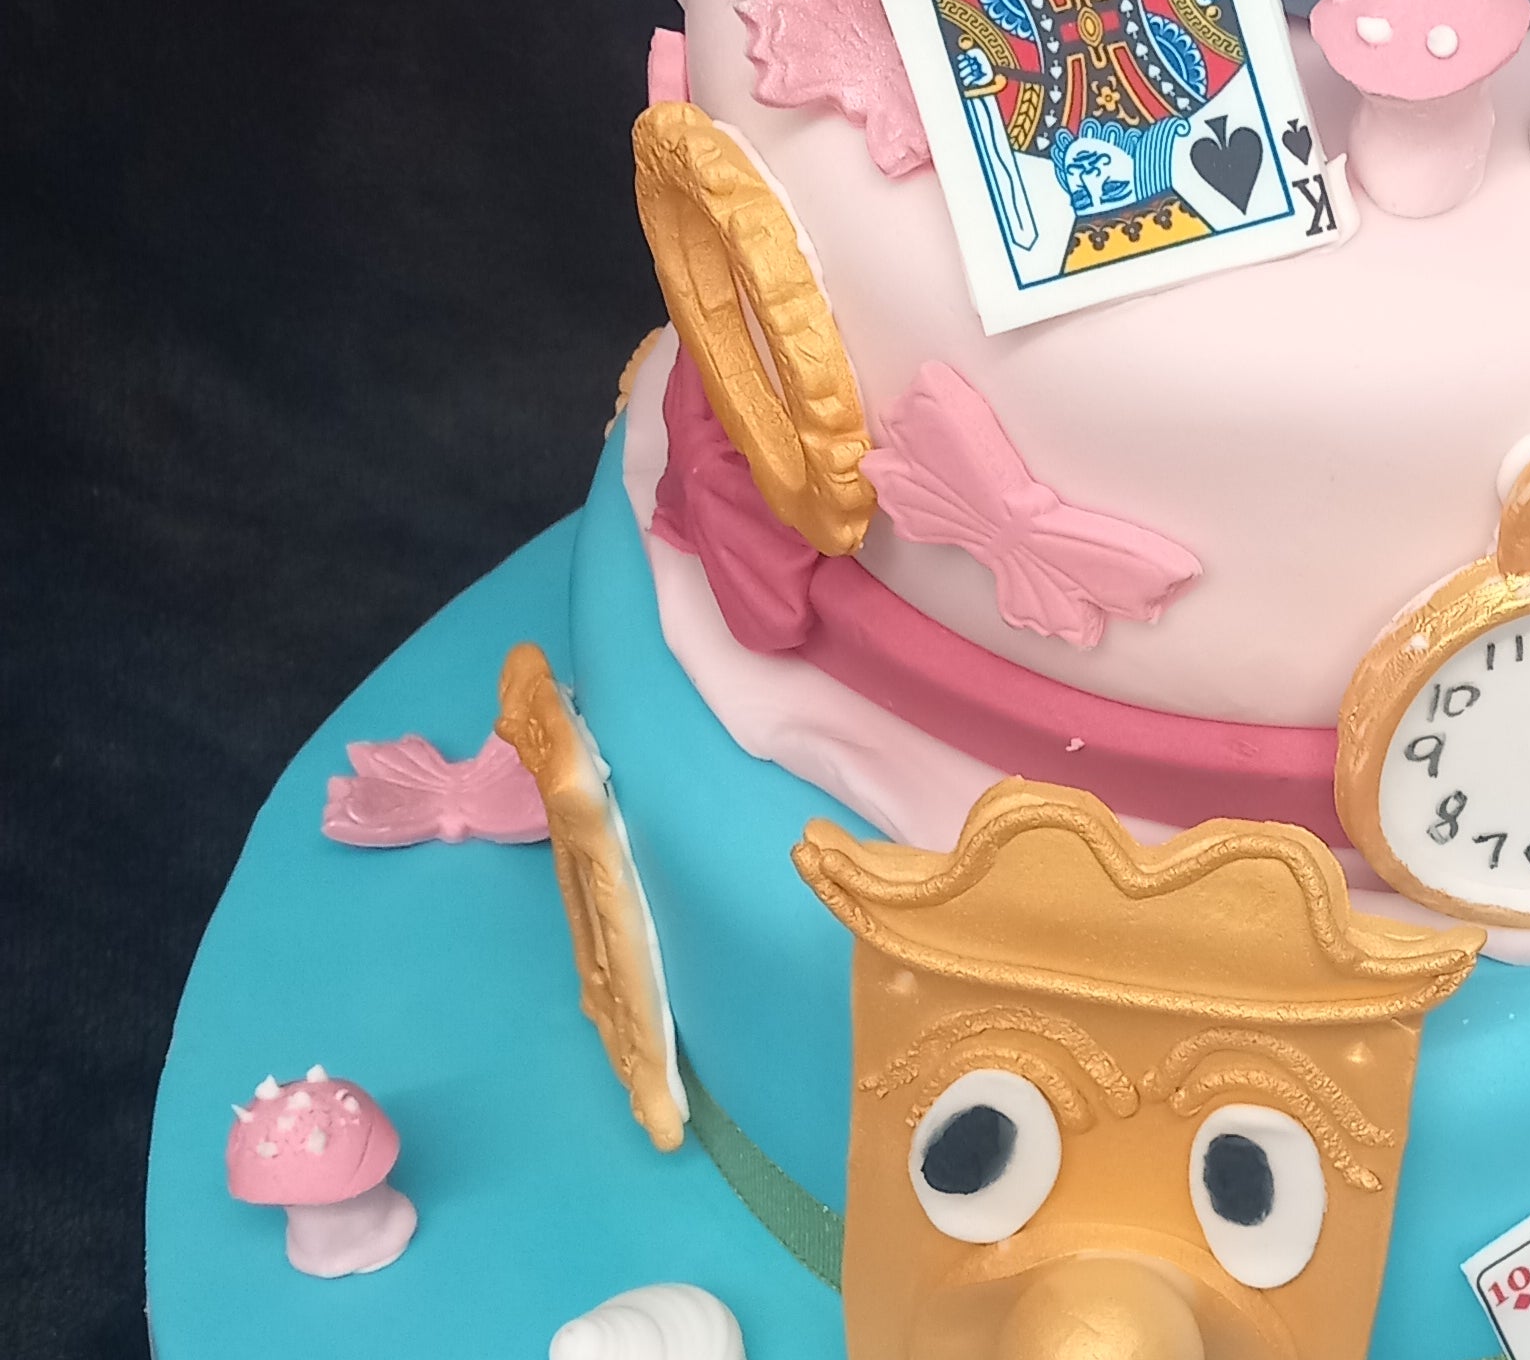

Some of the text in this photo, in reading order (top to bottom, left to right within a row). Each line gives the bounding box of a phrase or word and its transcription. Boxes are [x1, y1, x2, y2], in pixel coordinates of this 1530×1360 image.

[1292, 175, 1338, 236] K
[1486, 635, 1523, 671] 11
[1426, 683, 1481, 722] 10
[1403, 734, 1446, 778] 9
[1426, 789, 1467, 845] 8
[1472, 832, 1508, 869] 7
